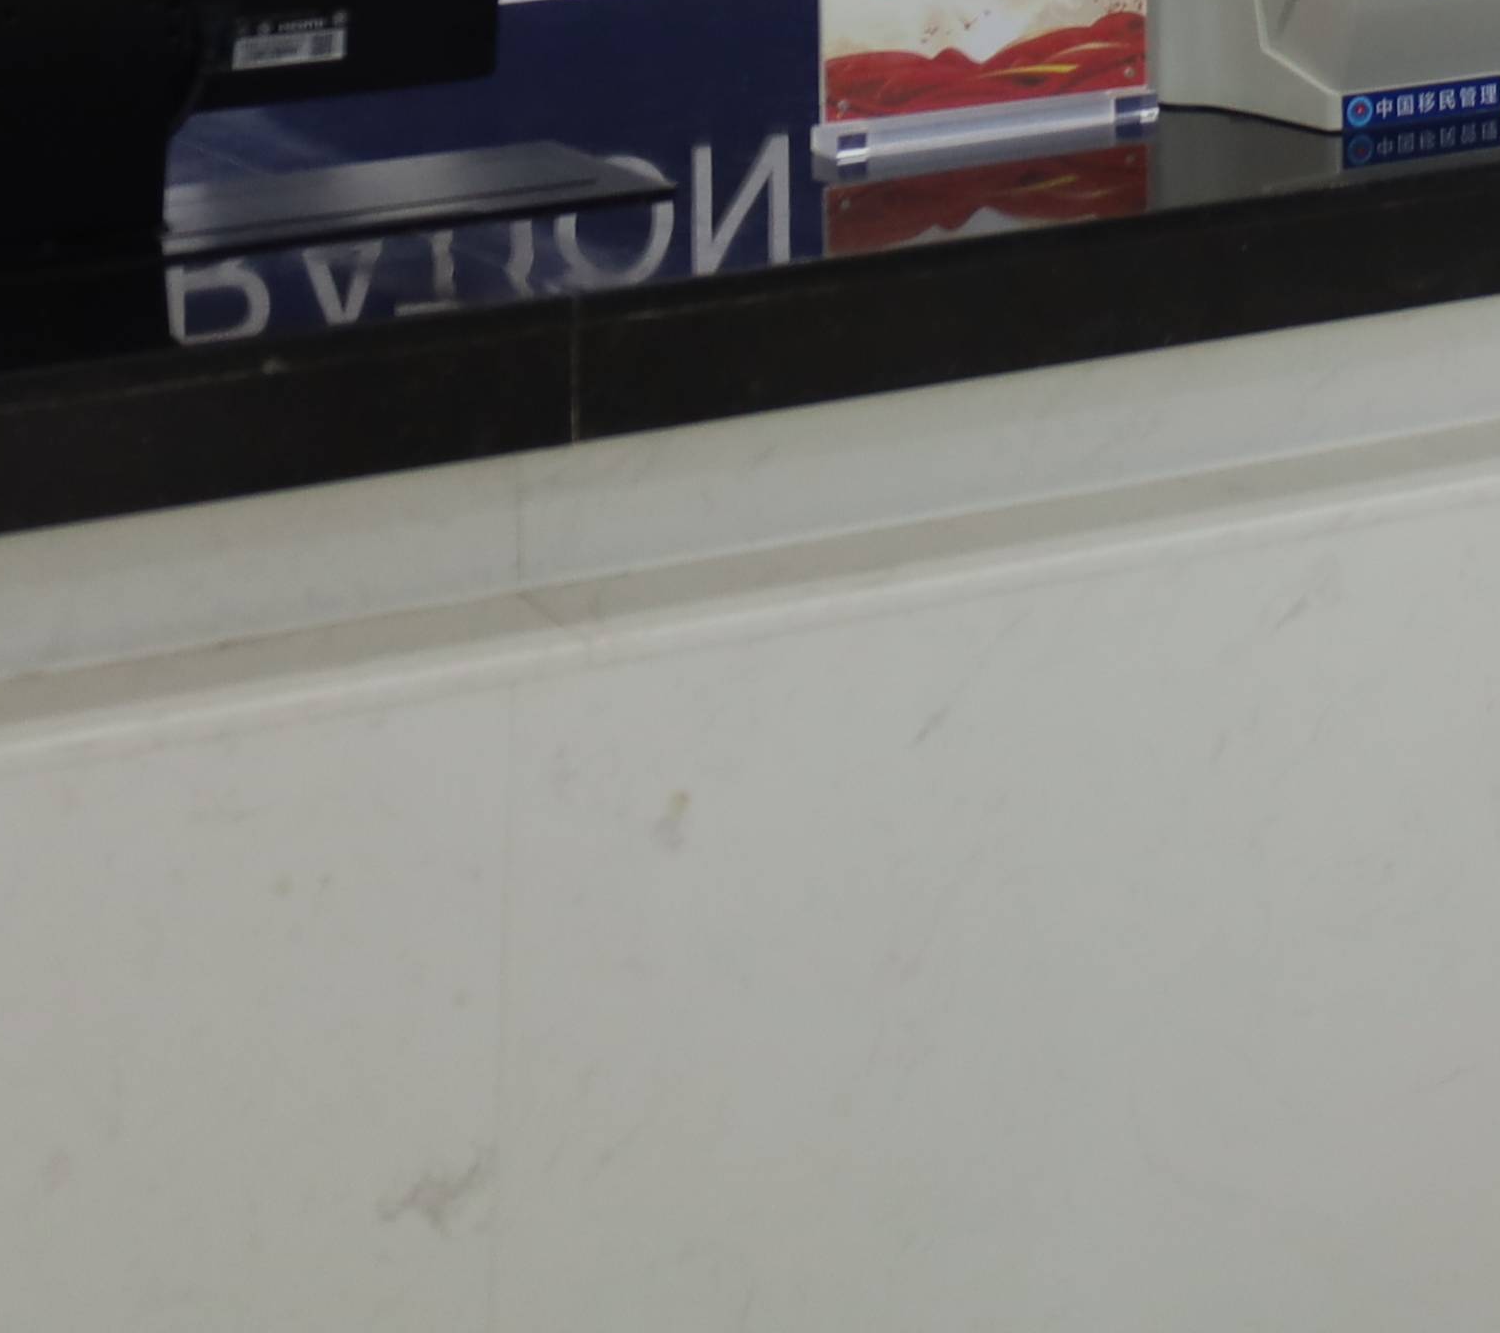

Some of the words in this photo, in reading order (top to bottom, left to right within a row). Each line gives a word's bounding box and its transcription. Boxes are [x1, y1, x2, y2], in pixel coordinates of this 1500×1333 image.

[1376, 83, 1498, 119] 中国移民管理
